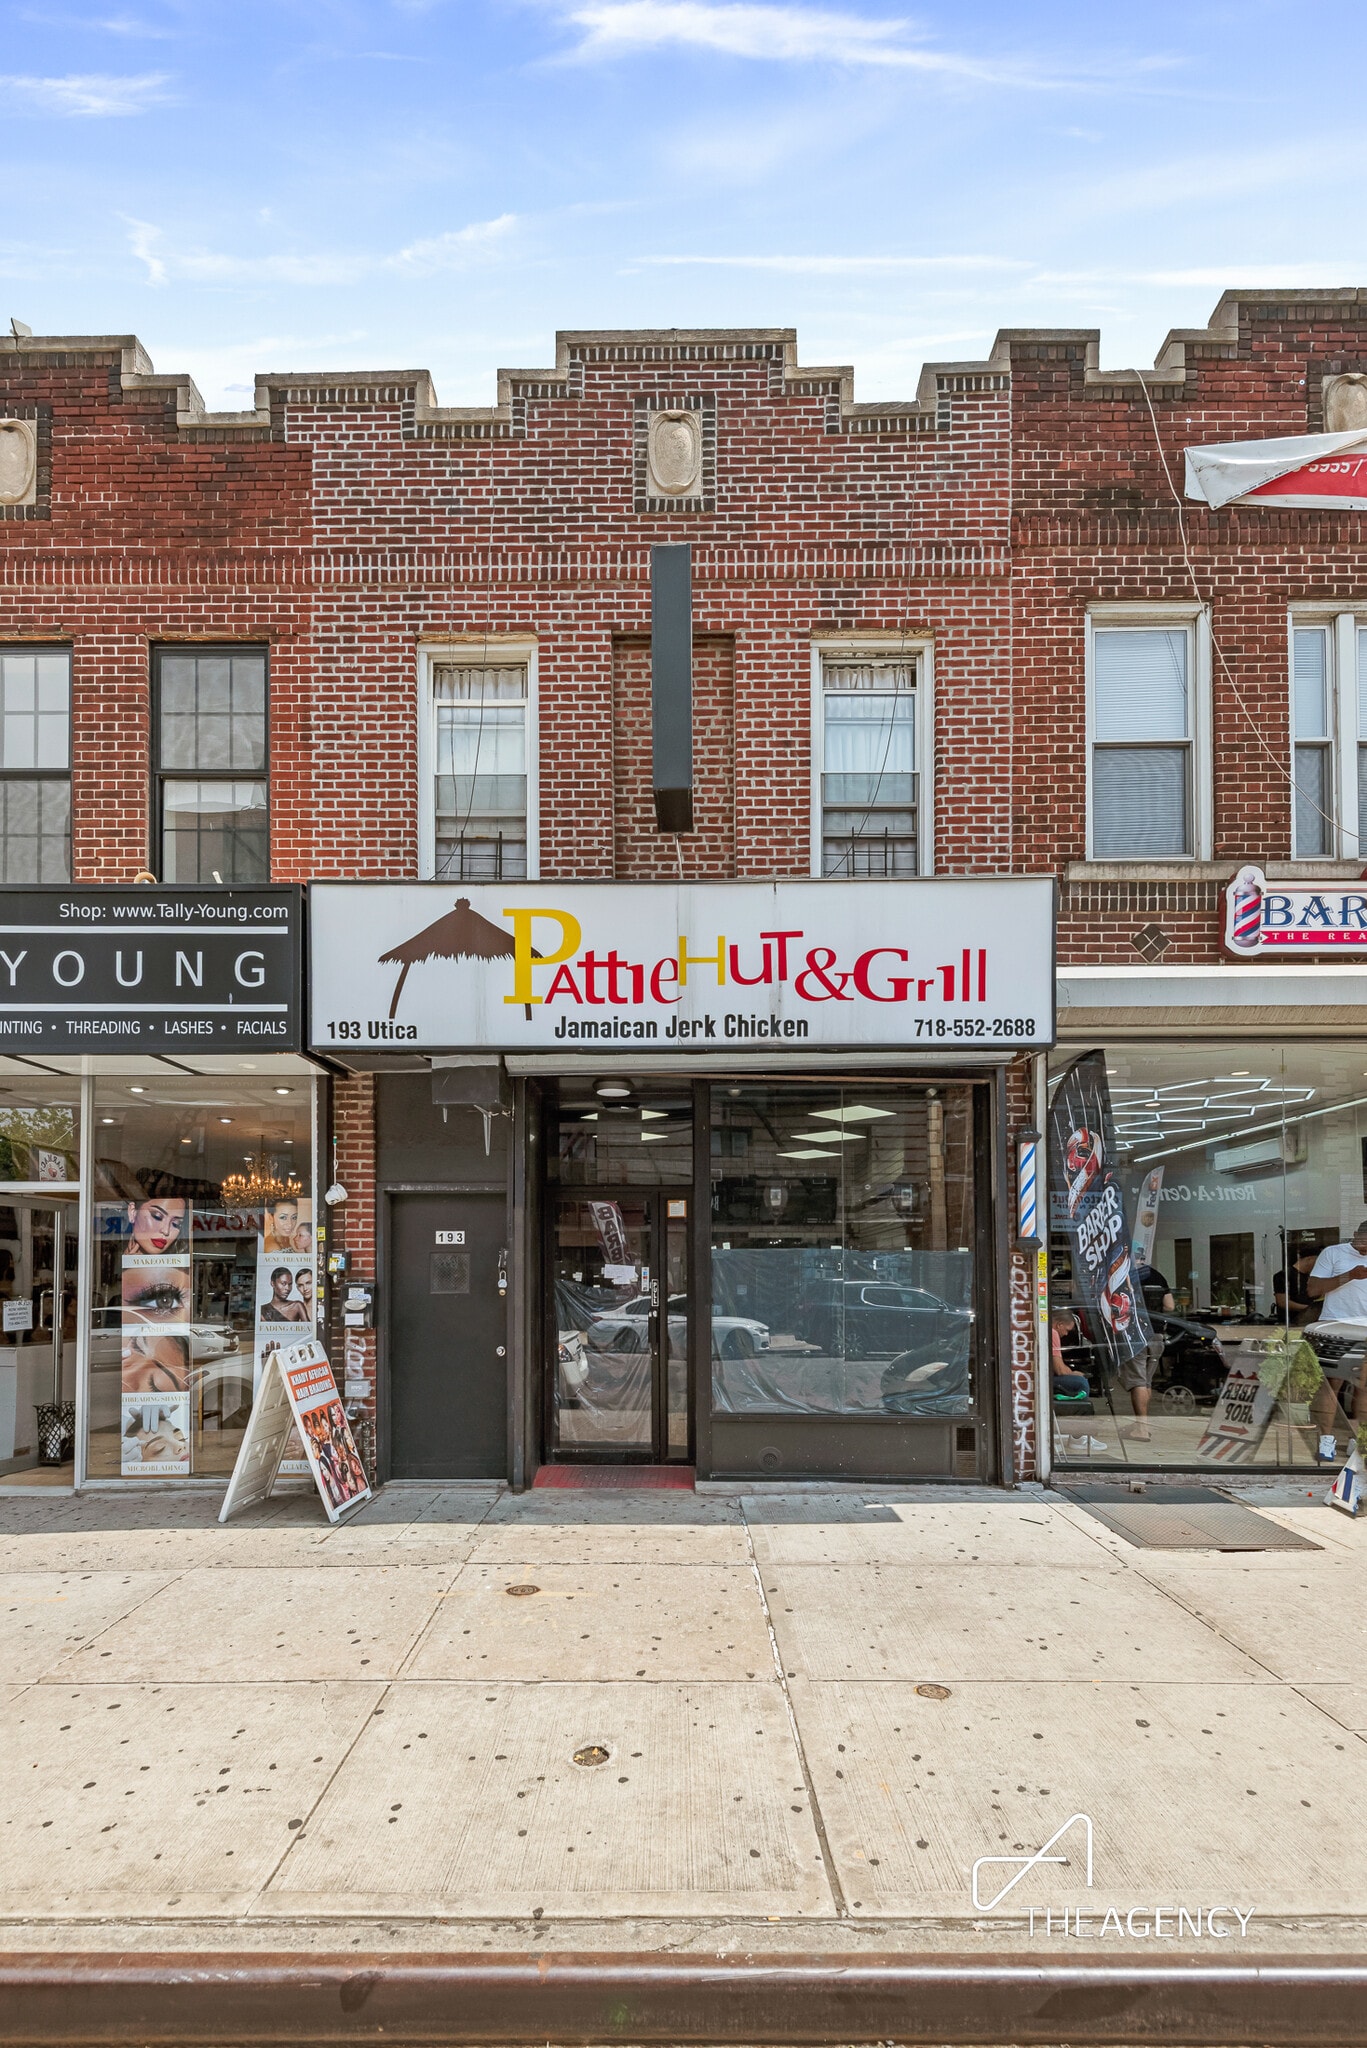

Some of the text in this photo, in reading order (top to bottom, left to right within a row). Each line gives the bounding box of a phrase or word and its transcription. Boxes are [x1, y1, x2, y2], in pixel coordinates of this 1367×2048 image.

[59, 903, 289, 921] Shop: www.Tally-Young.com
[1271, 932, 1367, 940] THE REA
[0, 950, 265, 987] YOUNG
[66, 1020, 141, 1034] THREADING
[164, 1020, 214, 1035] LASHES
[237, 1020, 287, 1035] FACIALS
[327, 1021, 418, 1040] 193 Utica
[554, 1014, 809, 1039] Jamaican Jerk Chicken
[914, 1018, 1035, 1037] 718-552-2688
[438, 1232, 464, 1243] 193
[1085, 1214, 1123, 1271] SHOP
[132, 1257, 182, 1265] MAKEOVERS
[127, 1464, 184, 1472] MICROBLADING
[281, 1463, 309, 1471] ACIALS
